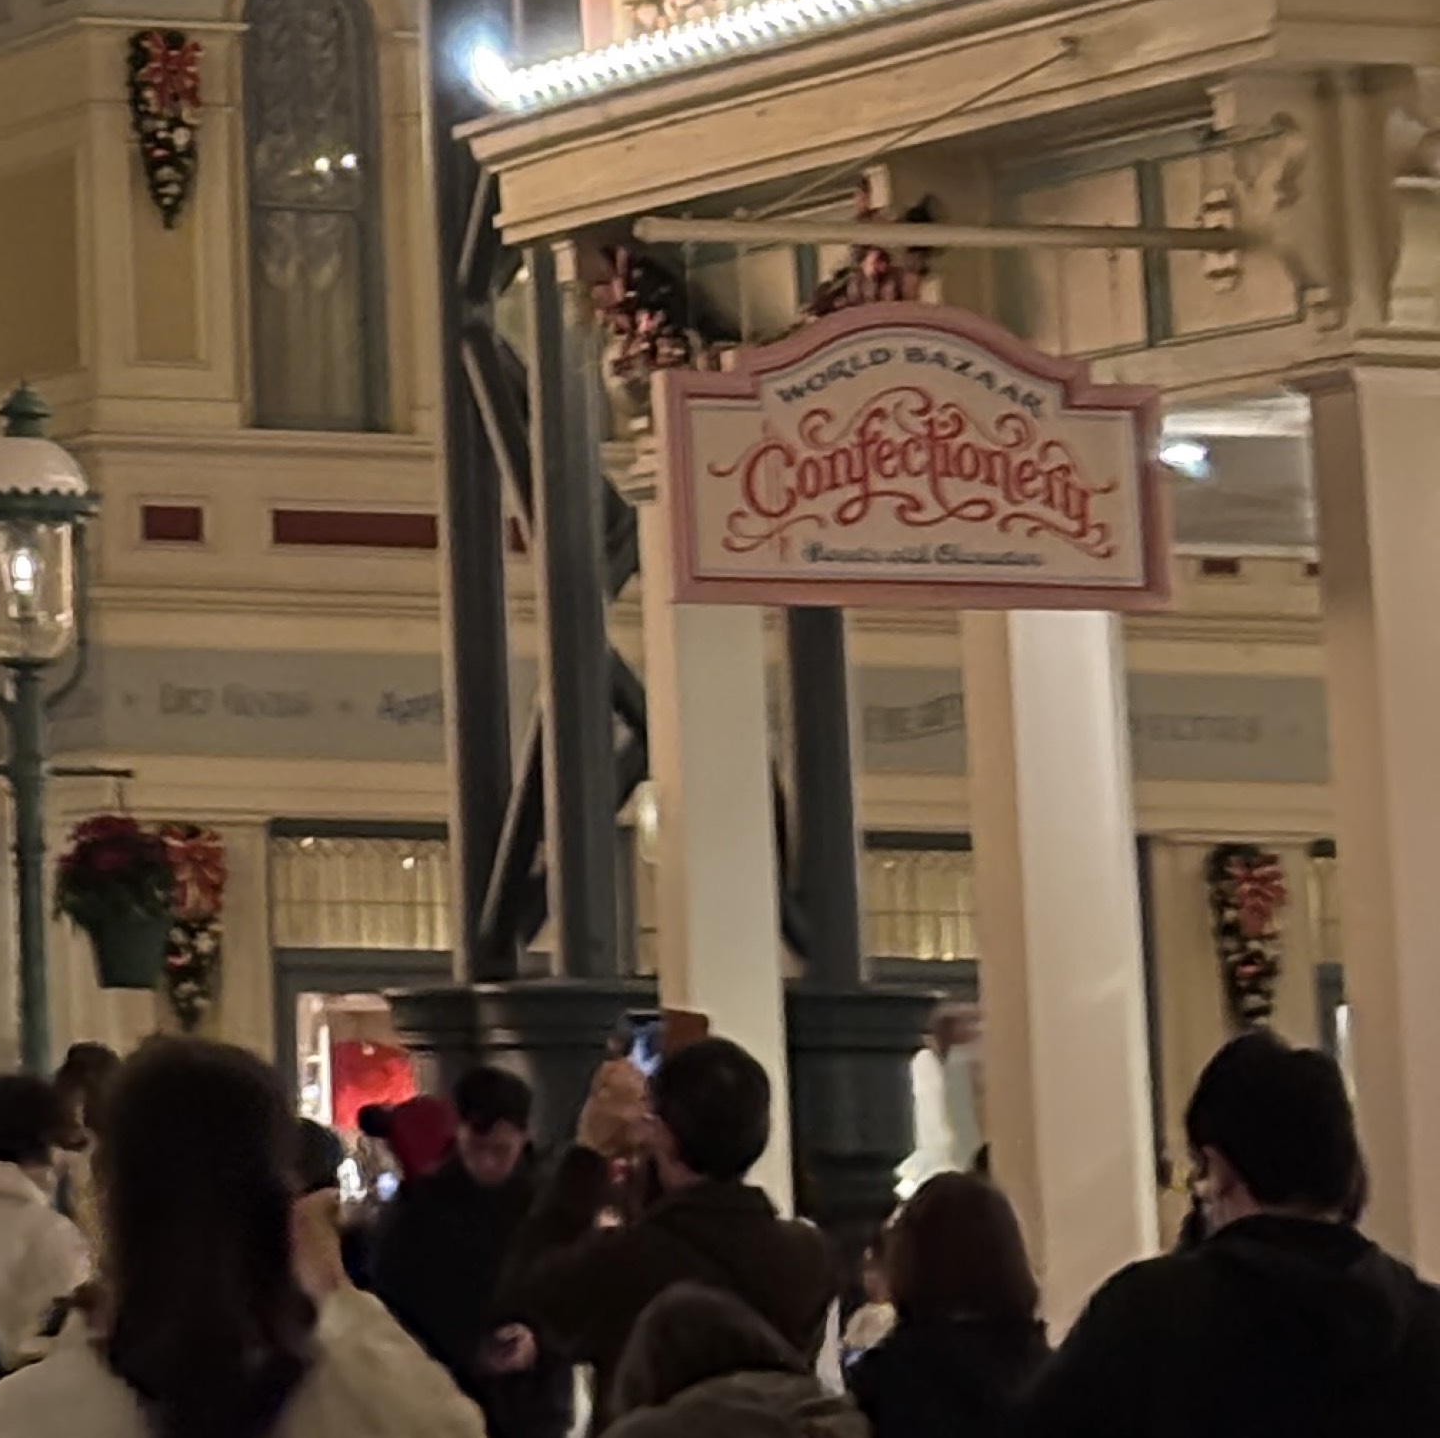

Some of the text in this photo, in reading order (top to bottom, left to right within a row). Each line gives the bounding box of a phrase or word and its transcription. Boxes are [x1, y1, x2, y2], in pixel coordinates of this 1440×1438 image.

[776, 346, 1042, 418] WORLD BAZAAR
[732, 396, 1102, 542] Confectionery
